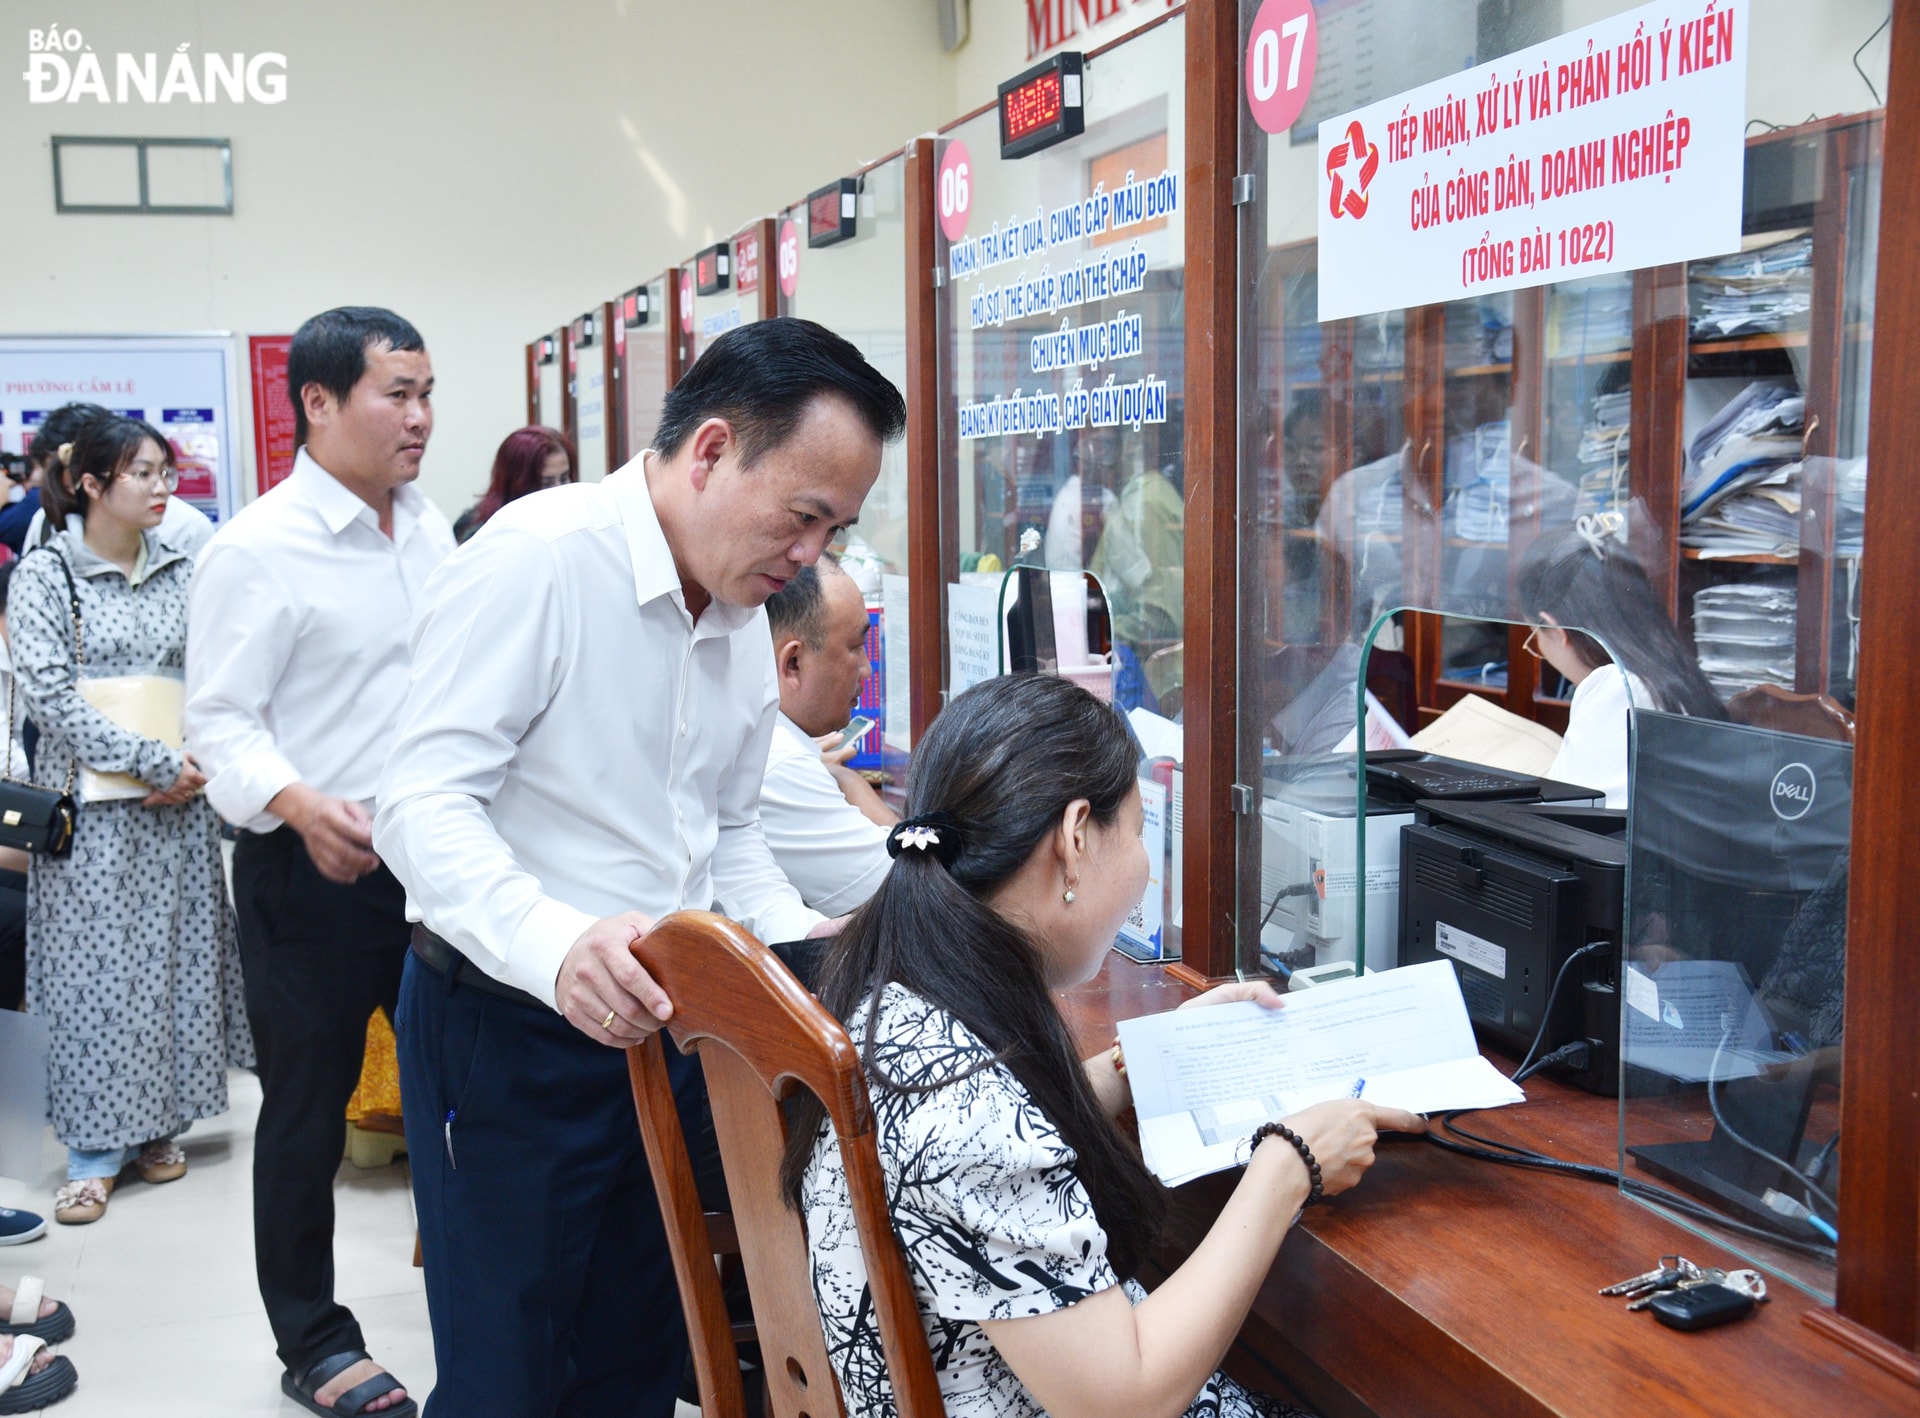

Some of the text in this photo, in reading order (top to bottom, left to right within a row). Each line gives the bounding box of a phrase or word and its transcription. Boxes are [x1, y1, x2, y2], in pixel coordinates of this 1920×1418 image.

[1253, 13, 1308, 102] 07
[1387, 0, 1734, 163] TIẾP NHẬN, XỬ LÝ VÀ PHẢN HỒI Ý KIẾN
[941, 162, 969, 218] 06
[1411, 108, 1691, 231] CỦA CÔNG DÂN, DOANH NGHIỆP
[779, 236, 797, 279] 05
[951, 236, 979, 279] NHẬN,
[981, 223, 999, 267] TRẢ
[1001, 216, 1019, 261] KẾT
[1050, 204, 1081, 245] CUNG
[1084, 184, 1109, 235] CẤP
[1113, 173, 1143, 227] MẪU
[1147, 173, 1177, 218] ĐƠN
[1462, 219, 1614, 288] (TỔNG ĐÀI 1022)
[680, 287, 694, 320] 04
[1005, 273, 1024, 319] THẾ
[1026, 263, 1056, 314] CHẤP,
[1059, 261, 1082, 306] XOÁ
[1085, 249, 1108, 300] THẾ
[1111, 239, 1146, 294] CHẤP
[1032, 311, 1141, 370] CHUYỂN MỤC ĐÍCH
[961, 374, 1164, 437] ĐĂNG KÝ BIẾN ĐỘNG, CẤP GIẤY DỰ ÁN
[1776, 781, 1809, 801] DELL
